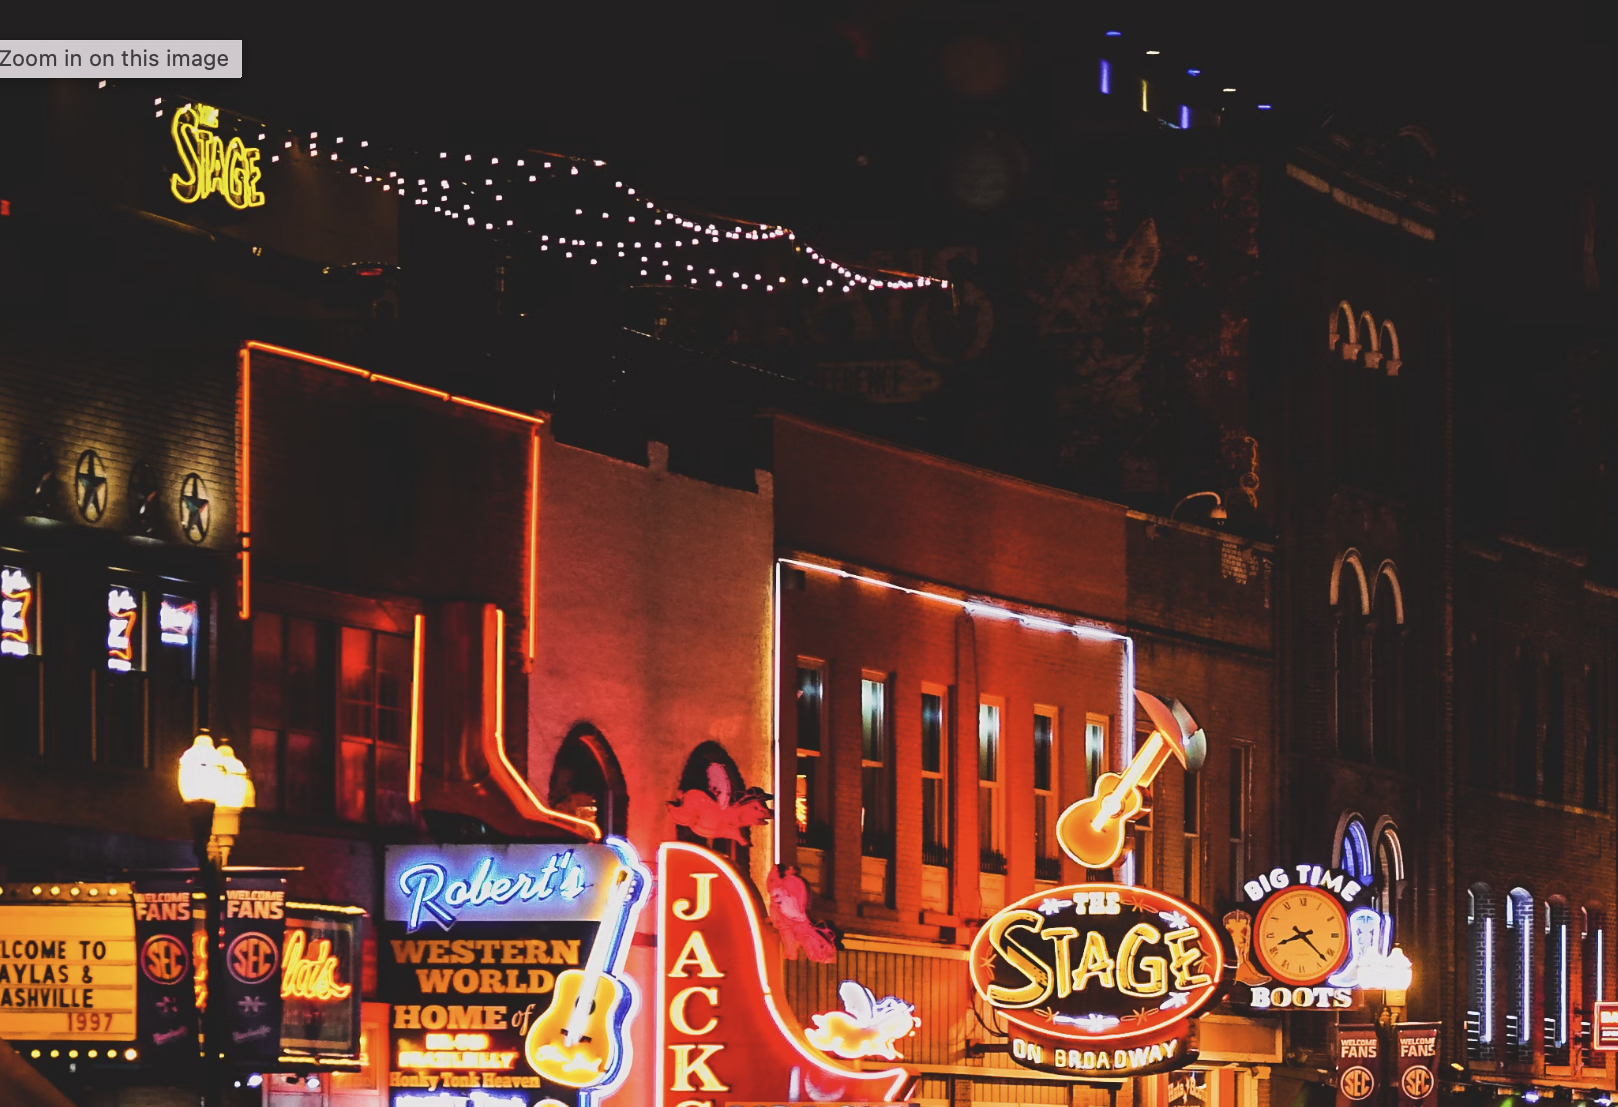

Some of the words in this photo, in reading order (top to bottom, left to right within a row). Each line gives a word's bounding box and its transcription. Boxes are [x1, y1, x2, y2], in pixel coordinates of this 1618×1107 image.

[169, 107, 265, 209] STAGE
[399, 849, 587, 934] Robert's
[1244, 868, 1289, 901] BIG
[1296, 864, 1362, 902] TIME
[134, 892, 191, 903] WELCOME
[226, 890, 285, 901] WELCOME
[1073, 892, 1120, 915] THE
[136, 902, 191, 921] FANS
[227, 900, 284, 920] FANS
[0, 940, 67, 960] LCOME
[79, 940, 107, 960] TO
[147, 940, 183, 979] SEC
[233, 938, 272, 979] SEC
[390, 939, 581, 965] WESTERN
[987, 909, 1212, 1009] STAGE
[0, 964, 69, 985] AYLAS
[82, 965, 94, 985] &
[416, 969, 555, 993] WORLD
[0, 988, 94, 1009] ASHVILLE
[1250, 987, 1352, 1008] BOOTS
[67, 1012, 113, 1032] 1997
[393, 1005, 508, 1030] HOME
[511, 1004, 536, 1036] of
[1341, 1046, 1377, 1058] FANS
[1400, 1037, 1436, 1045] WELCOME
[1400, 1044, 1436, 1057] FANS
[1012, 1038, 1041, 1064] ON
[1054, 1039, 1178, 1070] BROADWAY
[390, 1071, 439, 1091] Honky
[440, 1071, 481, 1088] Tonk
[482, 1072, 541, 1088] Heaven
[1344, 1069, 1370, 1097] SEC
[1405, 1069, 1430, 1096] SEC
